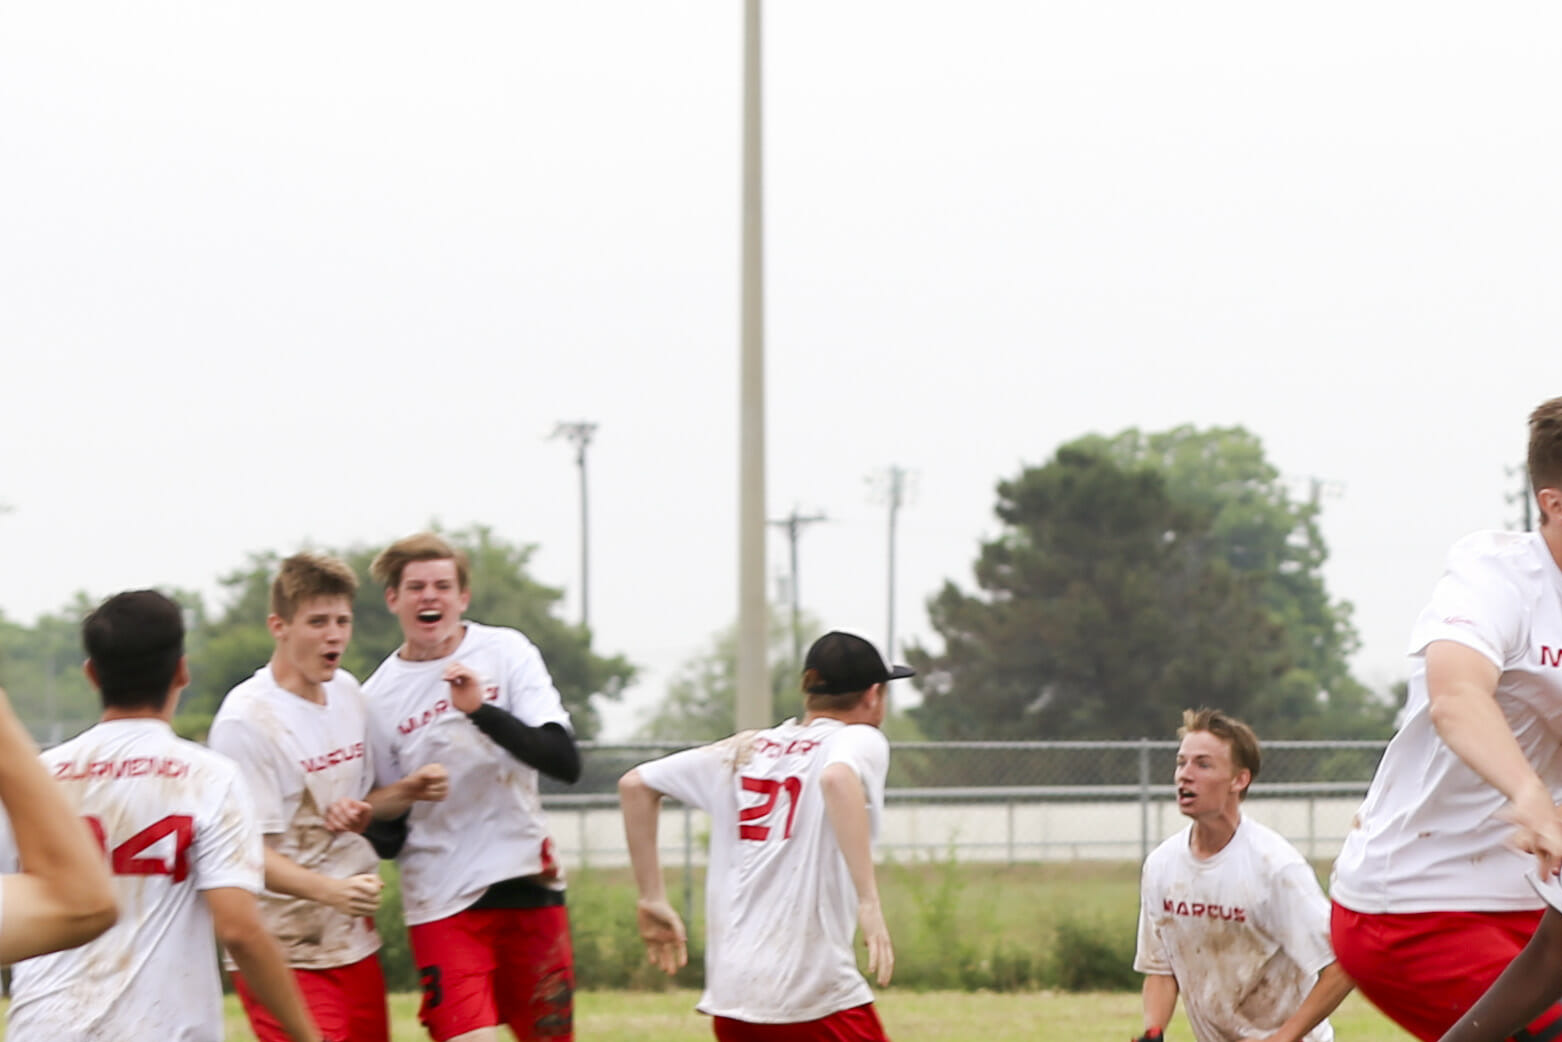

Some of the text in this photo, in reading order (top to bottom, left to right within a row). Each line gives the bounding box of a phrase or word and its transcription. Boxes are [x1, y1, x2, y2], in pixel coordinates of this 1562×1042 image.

[737, 774, 803, 843] 21
[80, 813, 196, 885] 4
[1162, 897, 1246, 924] MARCUS
